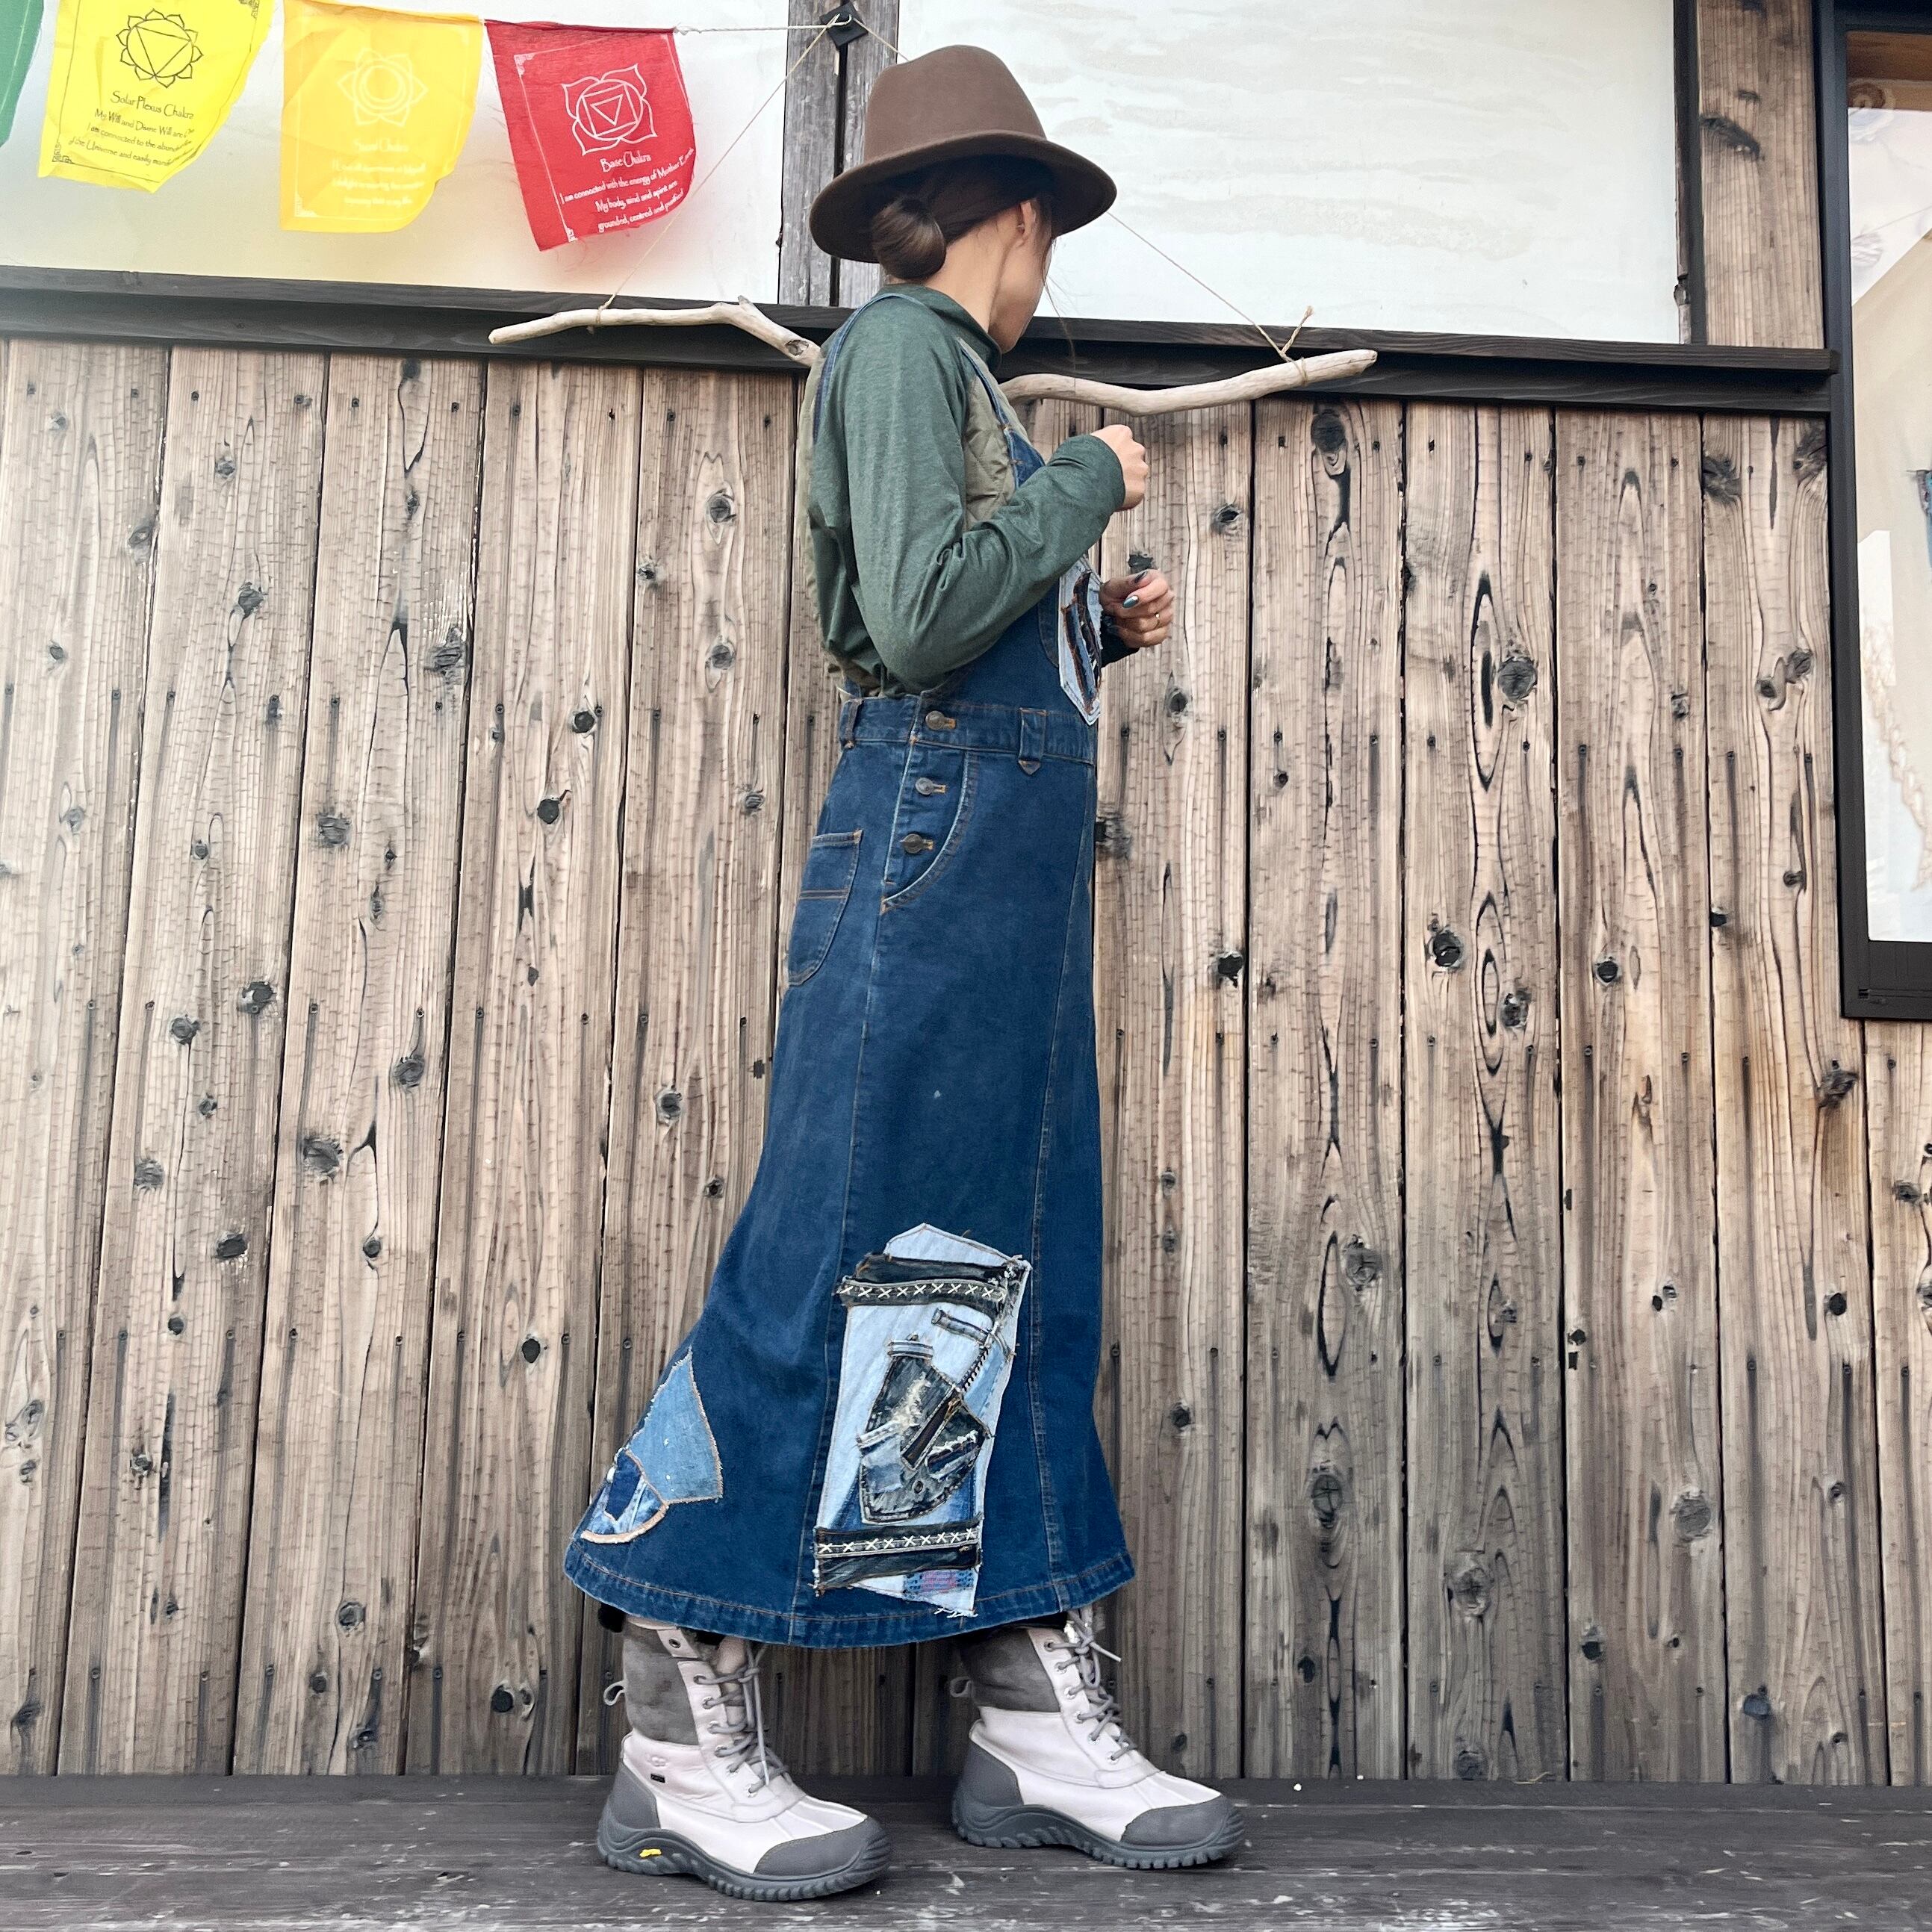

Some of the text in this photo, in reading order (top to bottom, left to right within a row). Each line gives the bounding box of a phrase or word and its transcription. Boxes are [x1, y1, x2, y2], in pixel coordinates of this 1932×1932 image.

[111, 90, 194, 119] Solar Plexus Chakra
[95, 108, 108, 121] My
[108, 111, 122, 123] Will
[121, 119, 135, 128] and
[159, 125, 173, 135] Will
[86, 139, 118, 156] Universe
[119, 150, 133, 159] and
[100, 129, 137, 145] connected
[145, 139, 156, 149] the
[600, 150, 652, 173] Base Chakra
[574, 180, 606, 199] connected
[618, 176, 630, 188] the
[629, 176, 650, 187] energy
[650, 168, 657, 181] of
[656, 162, 680, 179] Mother
[594, 199, 609, 214] My
[626, 193, 642, 205] mind
[640, 189, 653, 202] and
[652, 184, 668, 199] spirit
[668, 180, 678, 190] are
[653, 201, 665, 214] and
